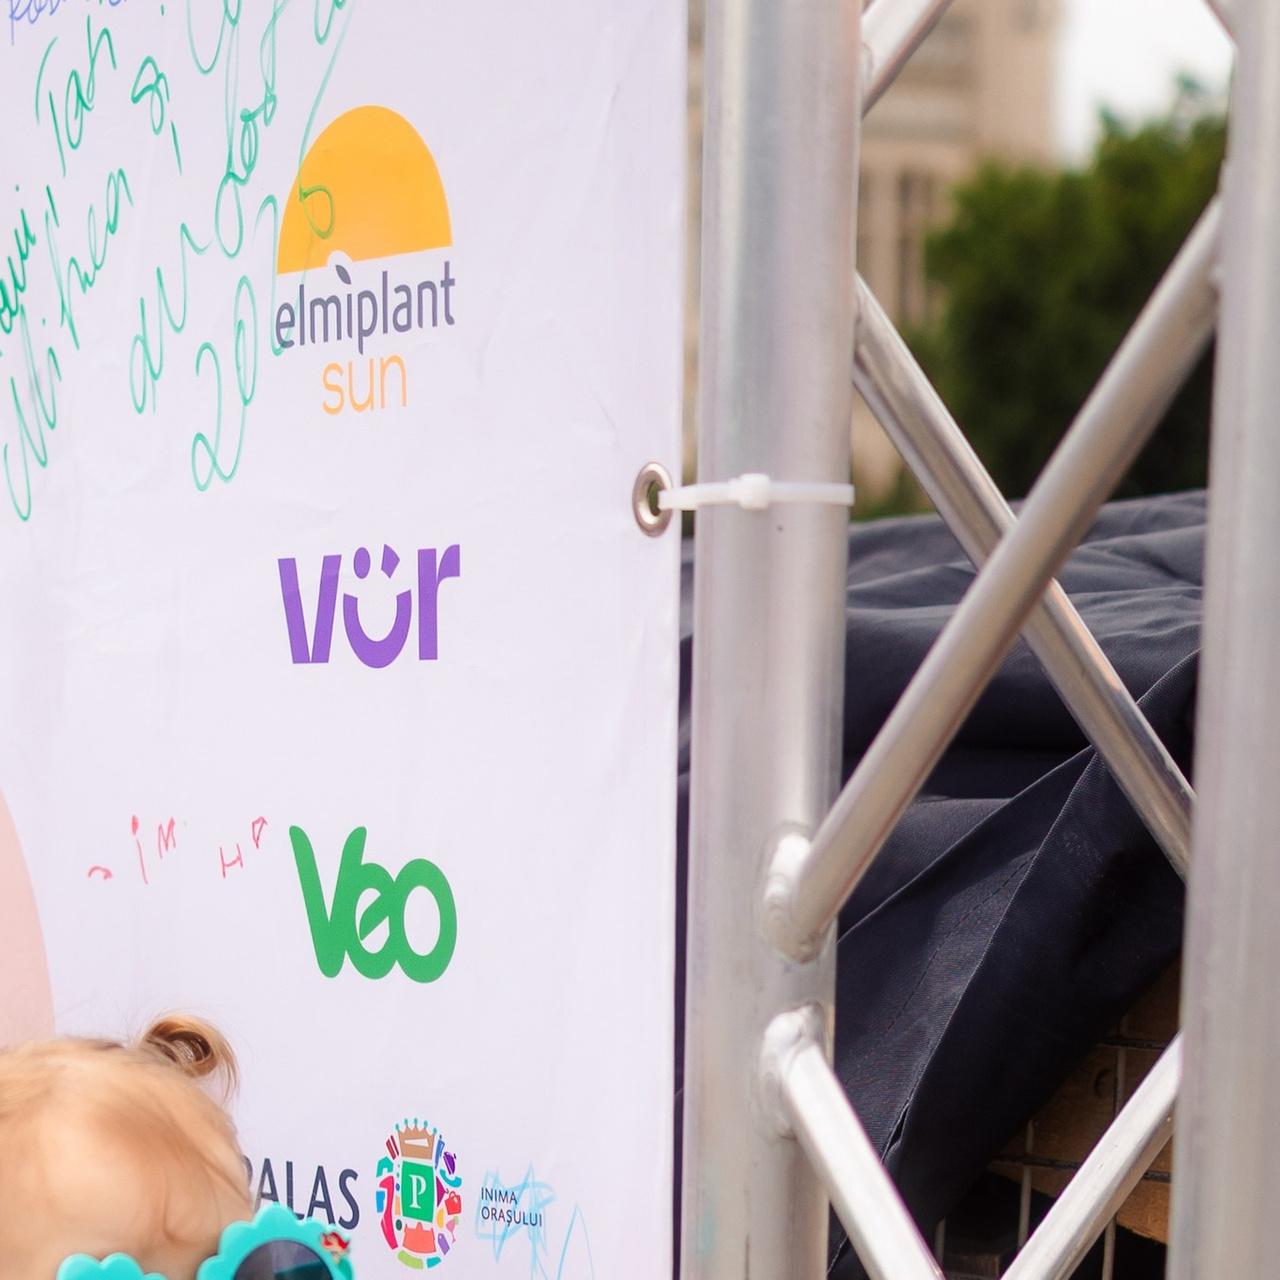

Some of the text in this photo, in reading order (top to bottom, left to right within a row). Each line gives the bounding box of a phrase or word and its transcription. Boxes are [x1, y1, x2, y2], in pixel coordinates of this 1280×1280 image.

[275, 260, 456, 356] elmiplant
[322, 355, 408, 416] sun
[480, 1186, 518, 1205] INIMA
